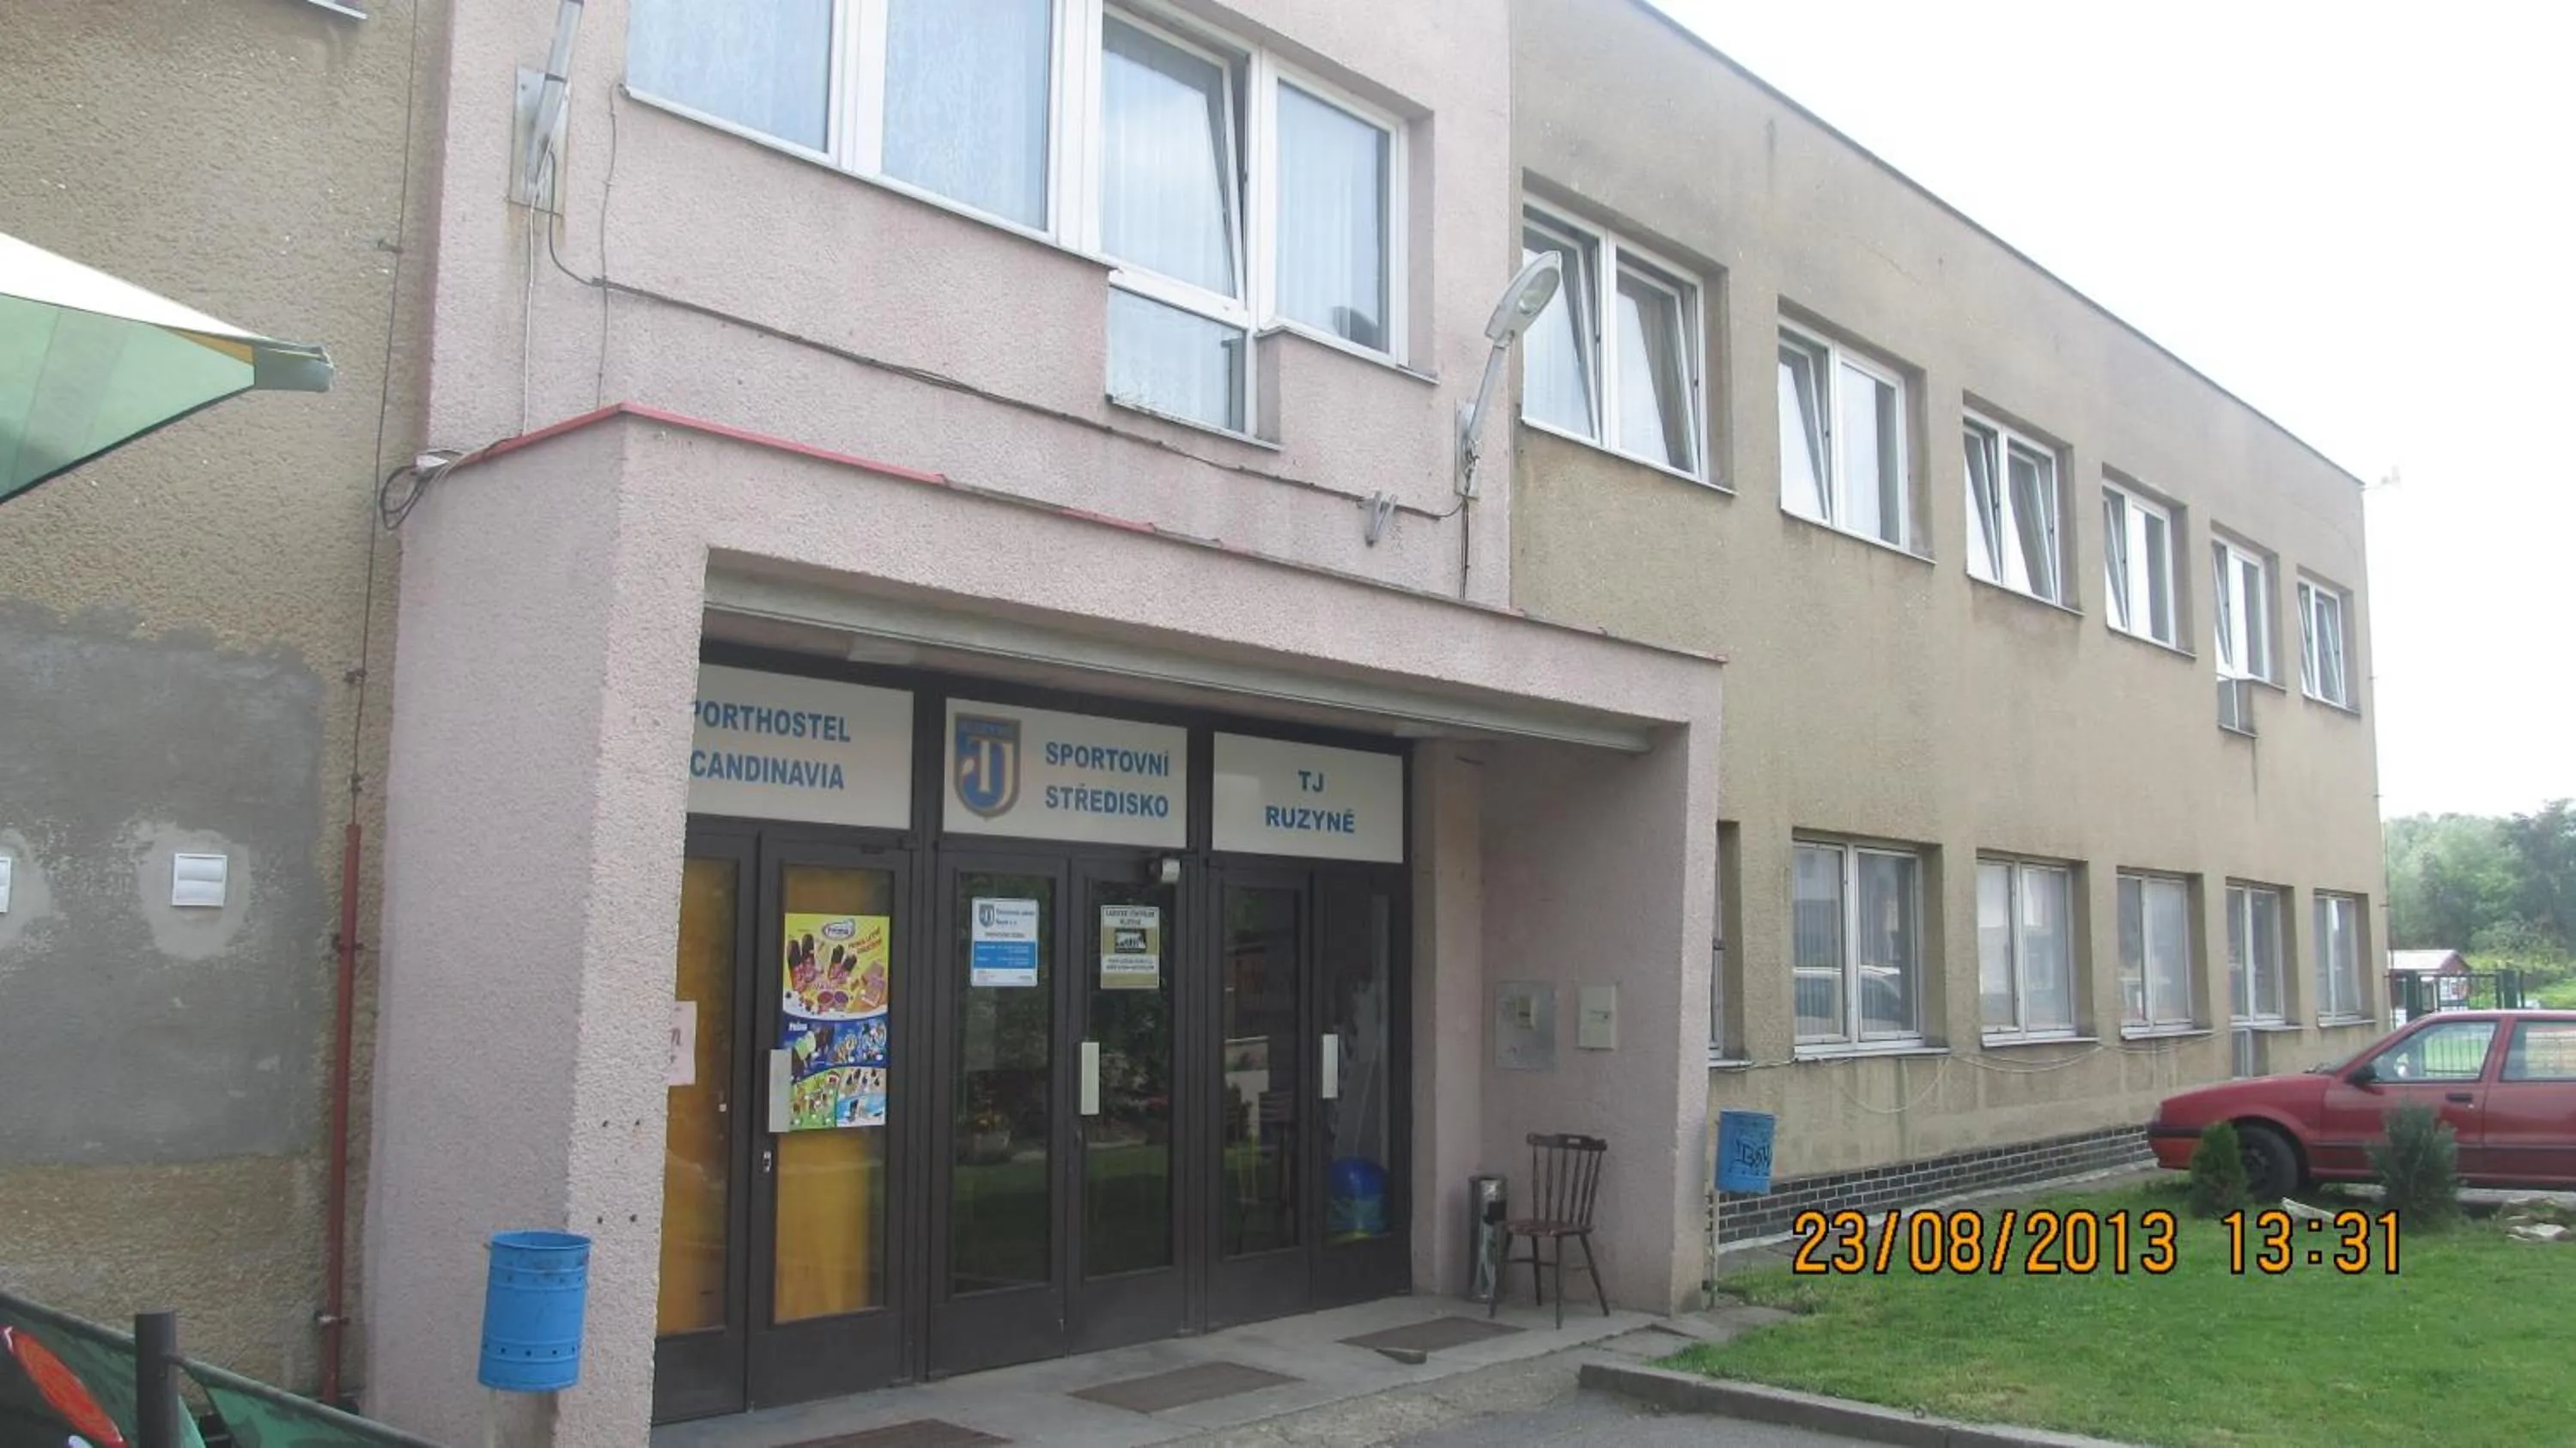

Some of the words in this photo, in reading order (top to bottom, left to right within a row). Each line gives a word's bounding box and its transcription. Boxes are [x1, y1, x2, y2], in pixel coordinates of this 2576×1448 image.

[690, 749, 844, 790] CANDINAVIA
[1045, 741, 1170, 776] SPORTOVNÍ
[1297, 770, 1324, 793] TJ
[1045, 783, 1169, 818] STŘEDISKO
